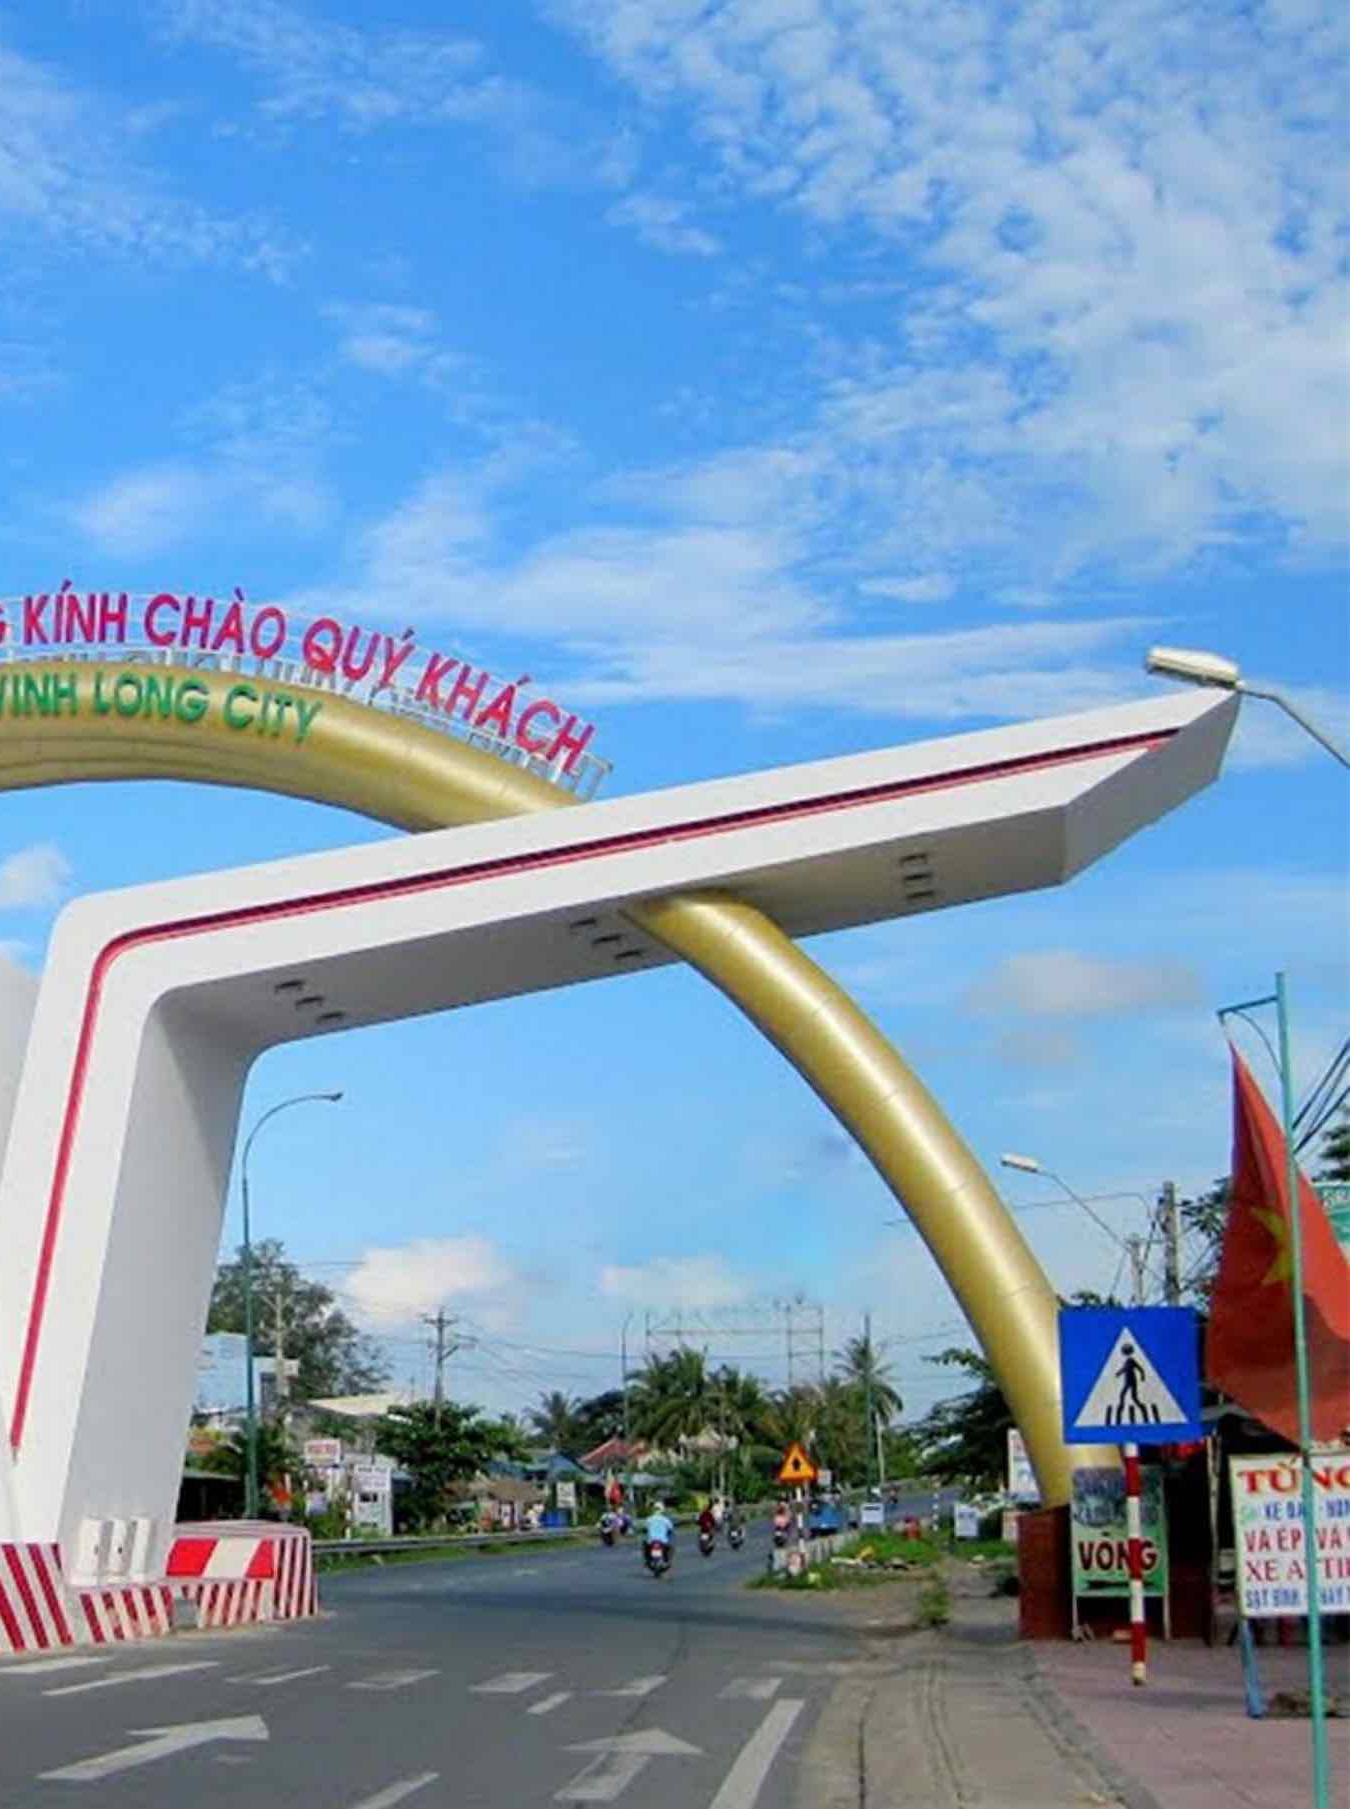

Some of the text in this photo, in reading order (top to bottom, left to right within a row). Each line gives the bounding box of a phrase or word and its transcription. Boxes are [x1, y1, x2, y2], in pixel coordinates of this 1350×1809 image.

[23, 579, 129, 645] KÍNH
[143, 588, 287, 660] CHÀO
[303, 617, 415, 688] QUÝ
[414, 653, 595, 774] KHÁCH
[93, 671, 210, 723] LONG
[223, 682, 323, 743] CITY
[1246, 1559, 1278, 1582] XE
